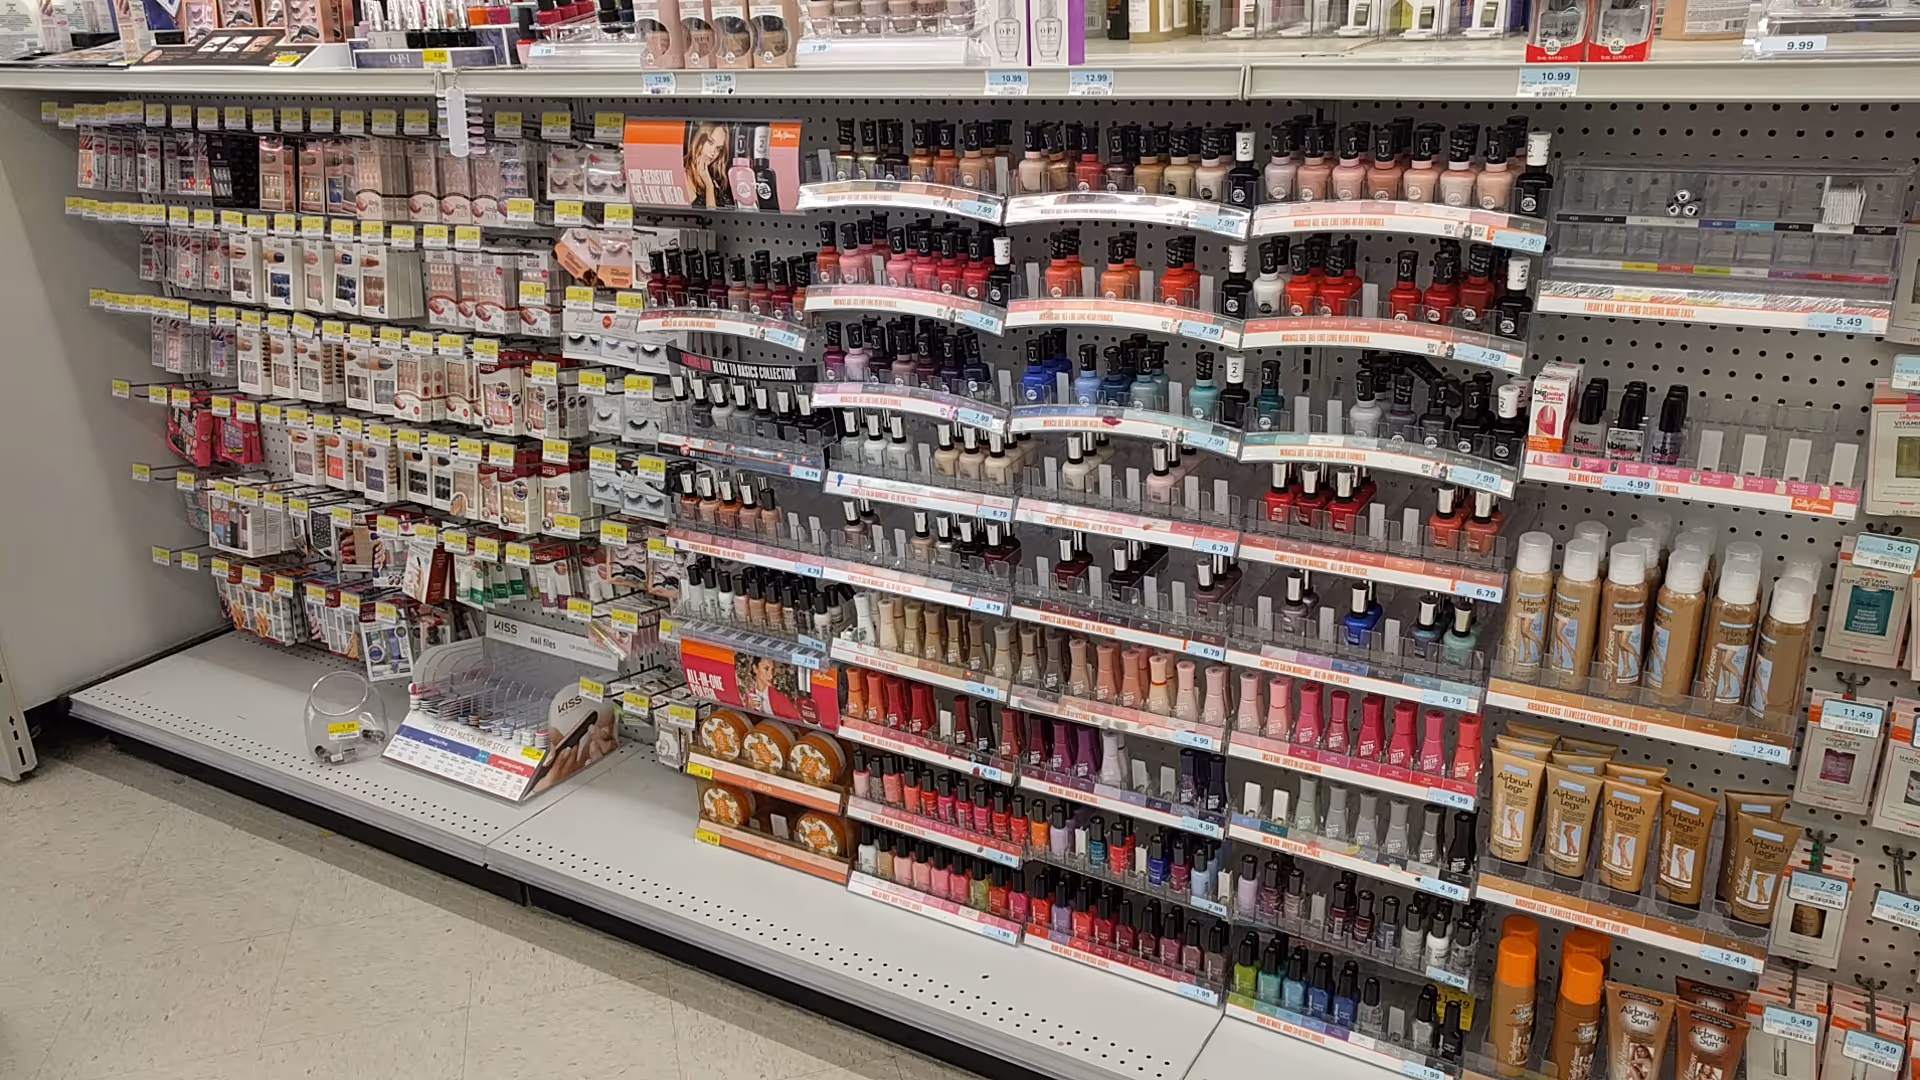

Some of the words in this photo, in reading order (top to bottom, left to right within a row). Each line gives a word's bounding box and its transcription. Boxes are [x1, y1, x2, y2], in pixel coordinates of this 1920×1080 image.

[812, 44, 826, 52] 7.99
[1787, 40, 1814, 50] 9.99
[1002, 74, 1022, 82] 10.99
[1086, 74, 1108, 82] 12.99
[1542, 72, 1571, 81] 10.99
[628, 169, 674, 185] CHIP-RESISTANT
[632, 184, 662, 204] GEL-LIKE
[976, 204, 992, 213] 7.99
[1217, 218, 1234, 227] 7.99
[979, 317, 994, 327] 7.99
[1836, 316, 1862, 326] 5.49
[1202, 326, 1219, 335] 7.99
[1480, 352, 1501, 362] 7.99
[712, 360, 729, 375] BLACK
[729, 363, 737, 376] TO
[737, 364, 758, 378] BASICS
[759, 366, 796, 380] COLLECTION
[1534, 388, 1546, 397] big
[1574, 435, 1589, 445] big
[1475, 473, 1495, 484] 7.99
[1578, 473, 1590, 482] MANI
[1627, 480, 1650, 489] 4.99
[1794, 499, 1810, 510] Sally
[1211, 544, 1229, 553] 6.79
[1887, 544, 1912, 554] 5.49
[1842, 578, 1870, 587] CUTICLE
[1872, 583, 1904, 591] REMOVER
[1476, 588, 1496, 598] 6.79
[1517, 598, 1546, 606] Airbrush
[1523, 603, 1538, 613] Legs
[494, 620, 518, 634] KISS
[530, 635, 542, 645] nail
[1203, 648, 1220, 657] 6.79
[1706, 647, 1718, 679] Hansen
[686, 668, 724, 691] ALL-IN-ONE
[557, 696, 583, 713] KISS
[1442, 696, 1462, 704] 6.79
[1528, 702, 1549, 714] AIRBRUSH
[1564, 709, 1586, 721] FLAWLESS
[1844, 708, 1873, 719] 11.49
[432, 723, 449, 735] FILES
[449, 727, 458, 736] TO
[458, 730, 476, 742] MATCH
[476, 737, 494, 748] YOUR
[492, 742, 511, 754] STYLE
[1826, 737, 1860, 747] COMPLETE
[1751, 745, 1780, 757] 12.49
[1497, 772, 1532, 788] Airbrush
[1504, 784, 1523, 794] Legs
[1449, 794, 1469, 805] 4.99
[1553, 789, 1590, 804] Airbrush
[1561, 800, 1580, 810] Legs
[1606, 800, 1645, 816] Airbrush
[1614, 810, 1635, 820] Legs
[1666, 809, 1704, 828] Airbrush
[1199, 823, 1214, 831] 4.99
[1673, 820, 1693, 832] Legs
[1745, 837, 1788, 852] Airbrush
[1754, 847, 1775, 859] Legs
[1440, 885, 1458, 895] 4.99
[1820, 881, 1842, 891] 7.29
[1208, 903, 1223, 912] 2.99
[1550, 907, 1571, 919] FLAWLESS
[1720, 952, 1746, 965] 12.49
[1620, 1005, 1659, 1022] Airbrush
[1631, 1015, 1649, 1027] Sun
[1791, 1016, 1812, 1027] 5.49
[1689, 1026, 1730, 1044] Airbrush
[1700, 1037, 1718, 1048] Sun
[1874, 1042, 1897, 1054] 5.49
[1423, 1069, 1440, 1079] 1.99
